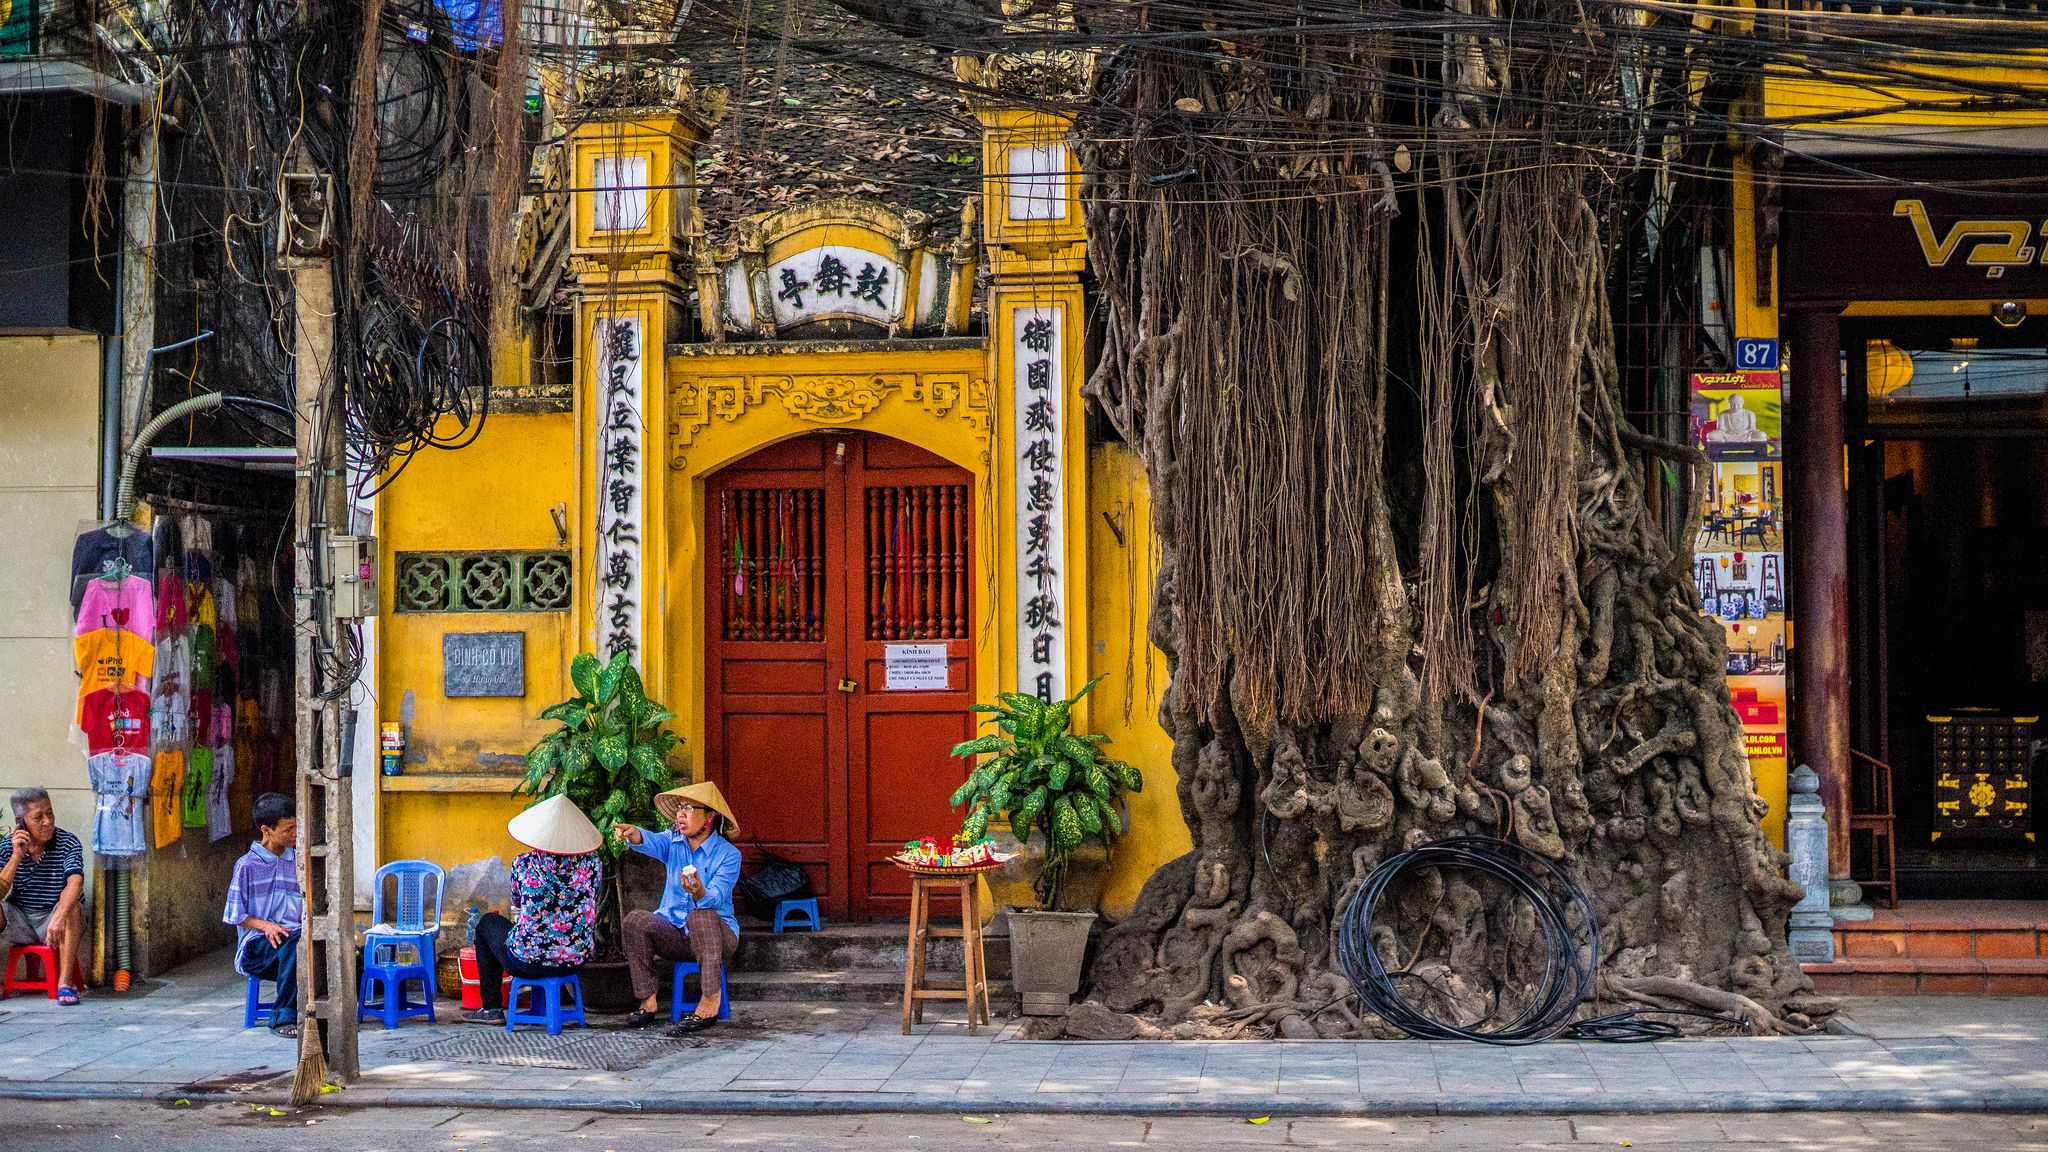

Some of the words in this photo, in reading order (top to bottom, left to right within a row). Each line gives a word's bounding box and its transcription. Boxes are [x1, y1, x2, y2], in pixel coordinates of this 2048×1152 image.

[1893, 200, 2048, 278] Vạ
[1745, 343, 1770, 364] 87
[1745, 735, 1776, 743] LOI.COM
